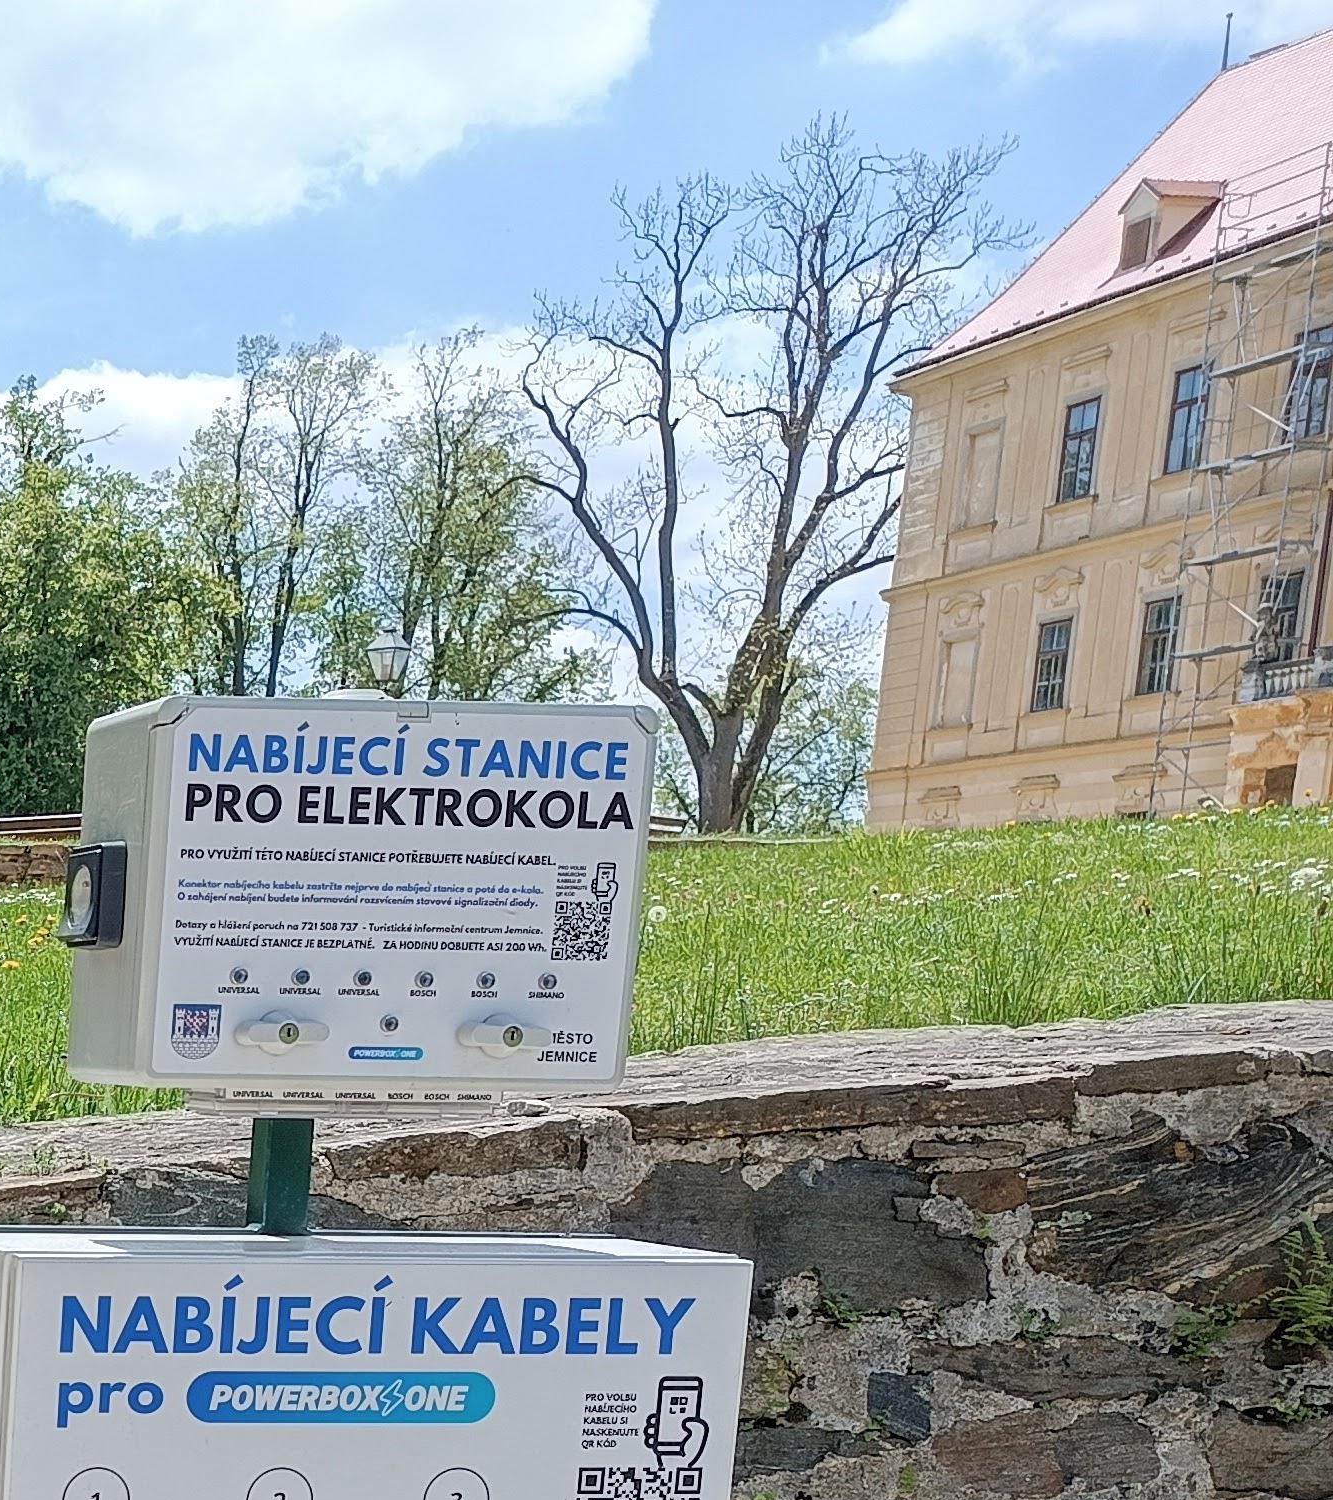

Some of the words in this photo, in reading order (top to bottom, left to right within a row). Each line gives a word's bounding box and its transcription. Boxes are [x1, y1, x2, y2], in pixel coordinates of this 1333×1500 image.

[188, 721, 410, 775] NABÍJECÍ
[422, 738, 629, 780] STANICE
[185, 783, 282, 823] PRO
[297, 785, 634, 830] ELEKTROKOLA
[180, 848, 205, 859] PRO
[207, 846, 253, 860] VYUŽITÍ
[255, 847, 283, 861] TÉTO
[285, 848, 336, 862] NABÍJECÍ
[338, 851, 386, 863] STANICE
[388, 850, 464, 864] POTŘEBUJETE
[465, 851, 516, 865] NABÍJECÍ
[517, 855, 556, 866] KABEL.
[178, 879, 222, 888] Konektor
[272, 881, 304, 890] kabelu
[344, 882, 380, 893] nejprve
[381, 883, 394, 892] do
[433, 884, 465, 893] stanice
[497, 885, 510, 894] do
[177, 891, 186, 901] O
[187, 892, 227, 904] zahájení
[228, 893, 266, 904] nabíjení
[267, 893, 300, 903] budete
[301, 894, 358, 904] informování
[175, 919, 207, 931] Dotazy
[253, 920, 285, 932] poruch
[301, 921, 318, 931] 721
[319, 922, 338, 931] 508
[339, 922, 359, 932] 737
[368, 922, 413, 932] Turistické
[414, 923, 464, 934] informační
[465, 925, 503, 934] centrum
[504, 924, 544, 935] Jemnice.
[173, 934, 214, 946] VYUŽITÍ
[261, 937, 303, 949] STANICE
[304, 938, 316, 949] JE
[399, 940, 439, 951] HODINU
[486, 942, 504, 952] ASI
[505, 942, 526, 952] 200
[218, 986, 260, 995] UNIVERSAL
[279, 987, 321, 996] UNIVERSAL
[338, 988, 380, 997] UNIVERSAL
[409, 989, 437, 998] BOSCH
[471, 990, 498, 999] BOSCH
[528, 991, 565, 1000] SHIMANO
[537, 1050, 598, 1063] JEMNICE
[232, 1090, 274, 1099] UNIVERSAL
[283, 1091, 325, 1099] UNIVERSAL
[335, 1092, 376, 1100] UNIVERSAL
[388, 1093, 414, 1101] BOSCH
[424, 1093, 450, 1101] BOSCH
[457, 1093, 492, 1101] SHIMANO
[59, 1274, 394, 1355] NABÍJECÍ
[410, 1296, 697, 1355] KABELY
[585, 1393, 605, 1401] PRO
[607, 1393, 637, 1401] VOLBU
[56, 1381, 164, 1428] pro
[208, 1384, 385, 1412] POWERBOX
[403, 1384, 470, 1412] ONE
[583, 1416, 618, 1424] KABELU
[619, 1416, 629, 1424] SI
[581, 1440, 594, 1449] QR
[596, 1438, 617, 1448] KÓD
